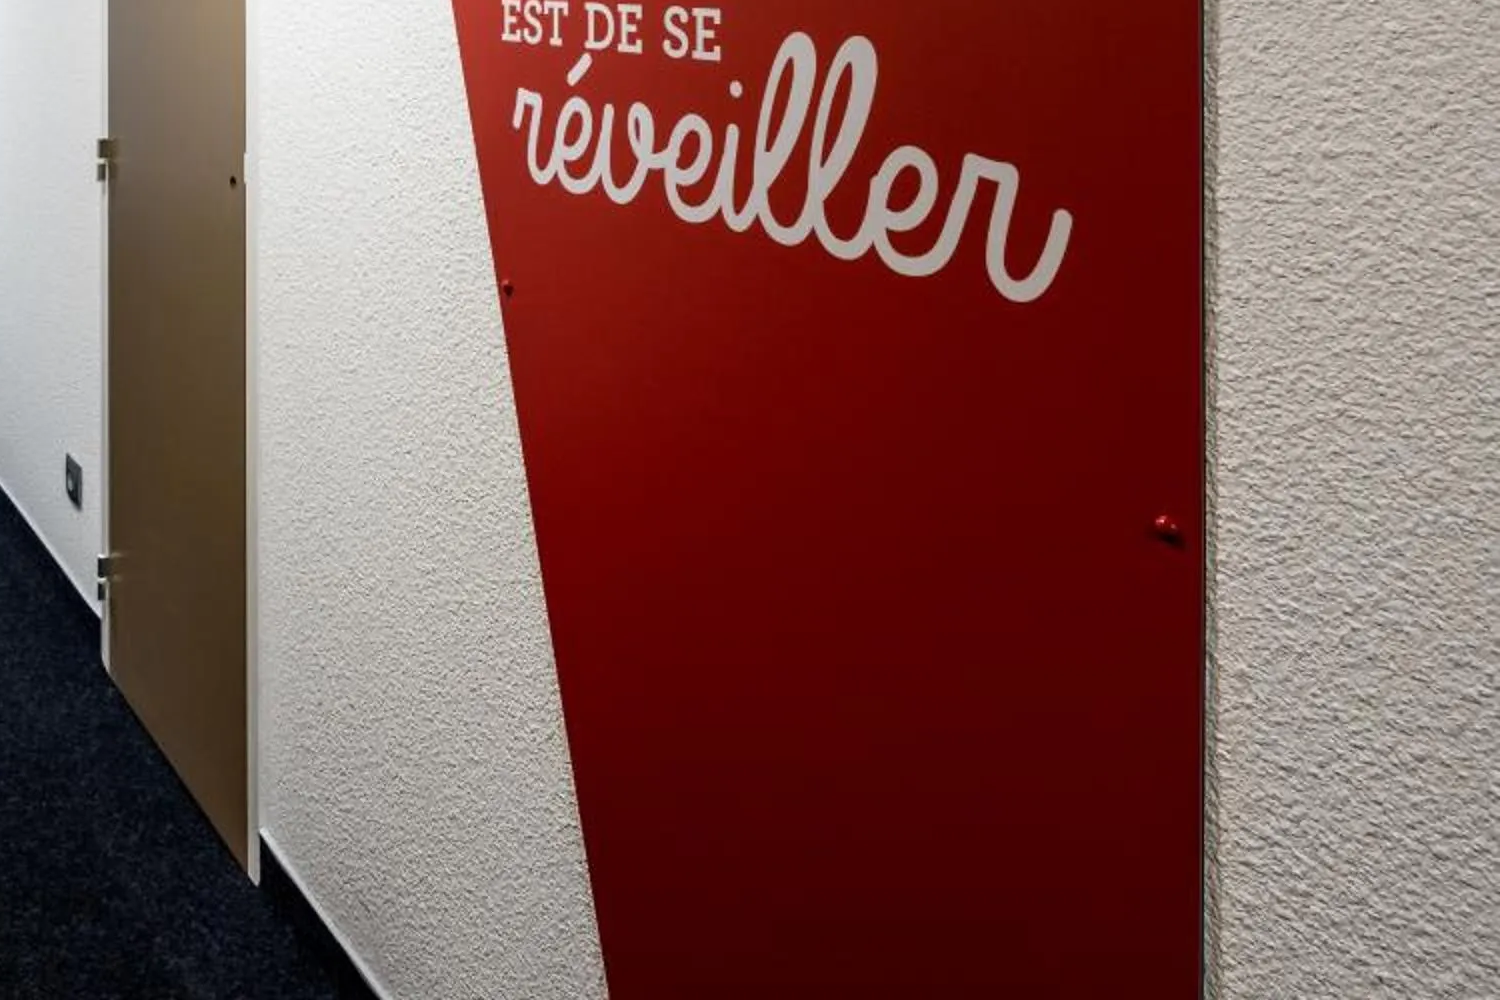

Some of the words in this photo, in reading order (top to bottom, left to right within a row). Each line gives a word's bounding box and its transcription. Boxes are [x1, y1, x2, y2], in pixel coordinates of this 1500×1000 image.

[582, 0, 645, 56] DE
[661, 4, 724, 65] SE
[511, 30, 1075, 304] réveiller
